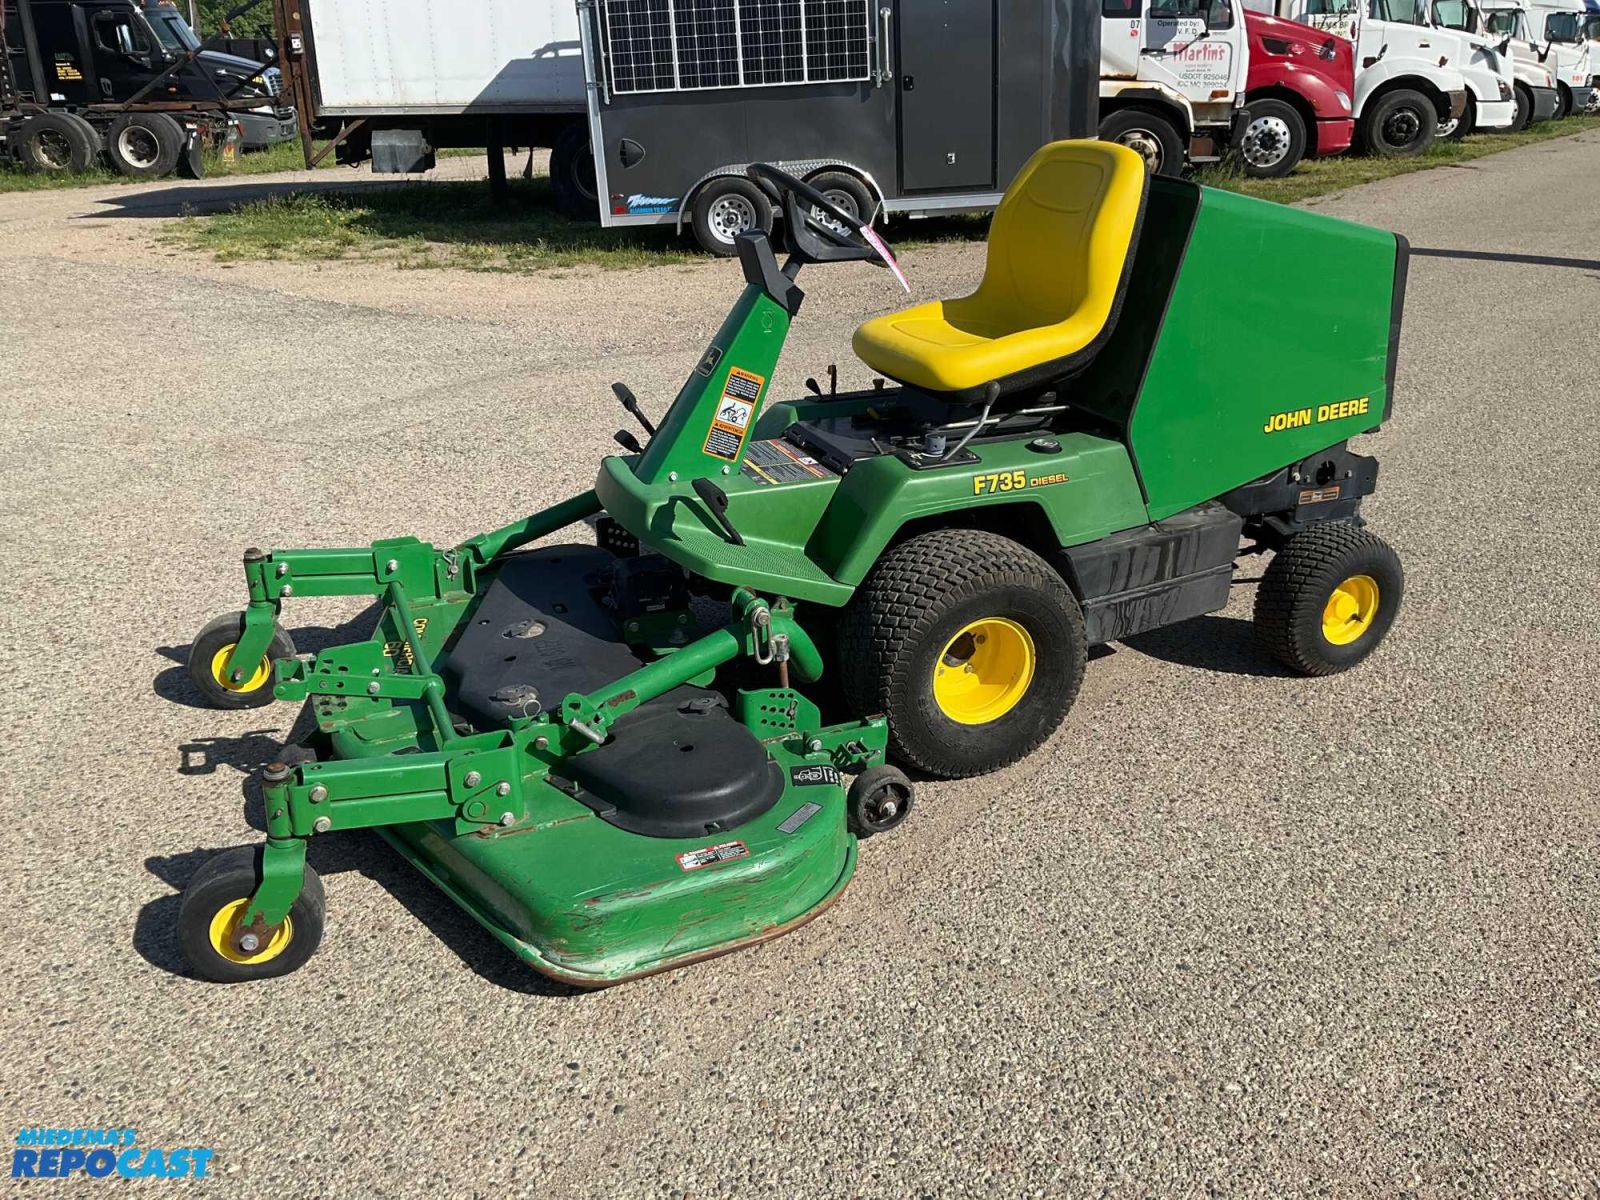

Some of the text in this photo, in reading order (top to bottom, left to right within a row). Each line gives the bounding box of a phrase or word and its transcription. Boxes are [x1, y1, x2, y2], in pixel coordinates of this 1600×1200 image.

[1157, 19, 1200, 28] Operated by:
[1173, 43, 1225, 62] Martin's
[1264, 397, 1369, 433] JOHN DEERE
[973, 470, 1069, 495] F735 DIESEL
